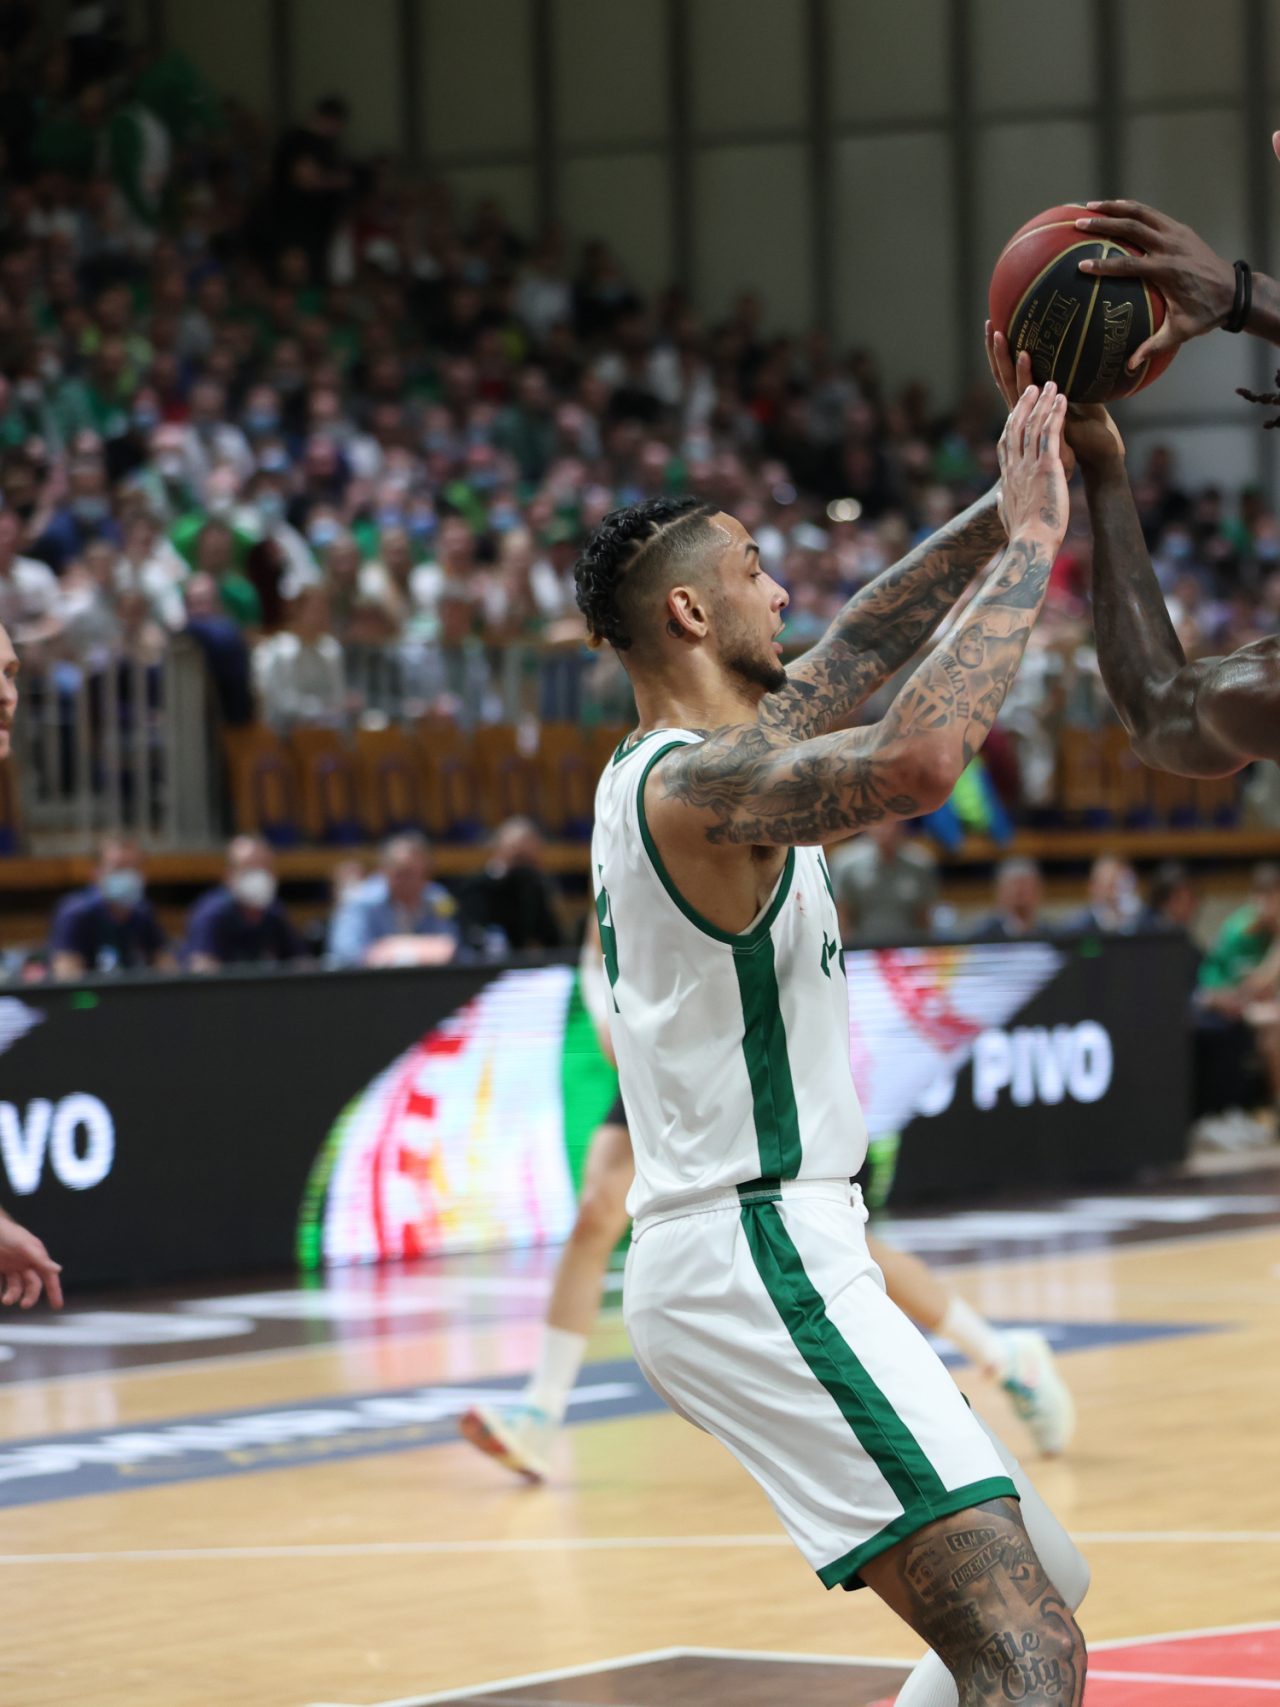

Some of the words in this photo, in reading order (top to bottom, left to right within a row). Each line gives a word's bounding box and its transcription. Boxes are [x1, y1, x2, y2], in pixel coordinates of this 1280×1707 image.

[972, 1020, 1114, 1111] PIVO
[951, 1531, 978, 1550] ELM
[953, 1547, 993, 1586] LIBERTY
[1001, 1655, 1069, 1701] City
